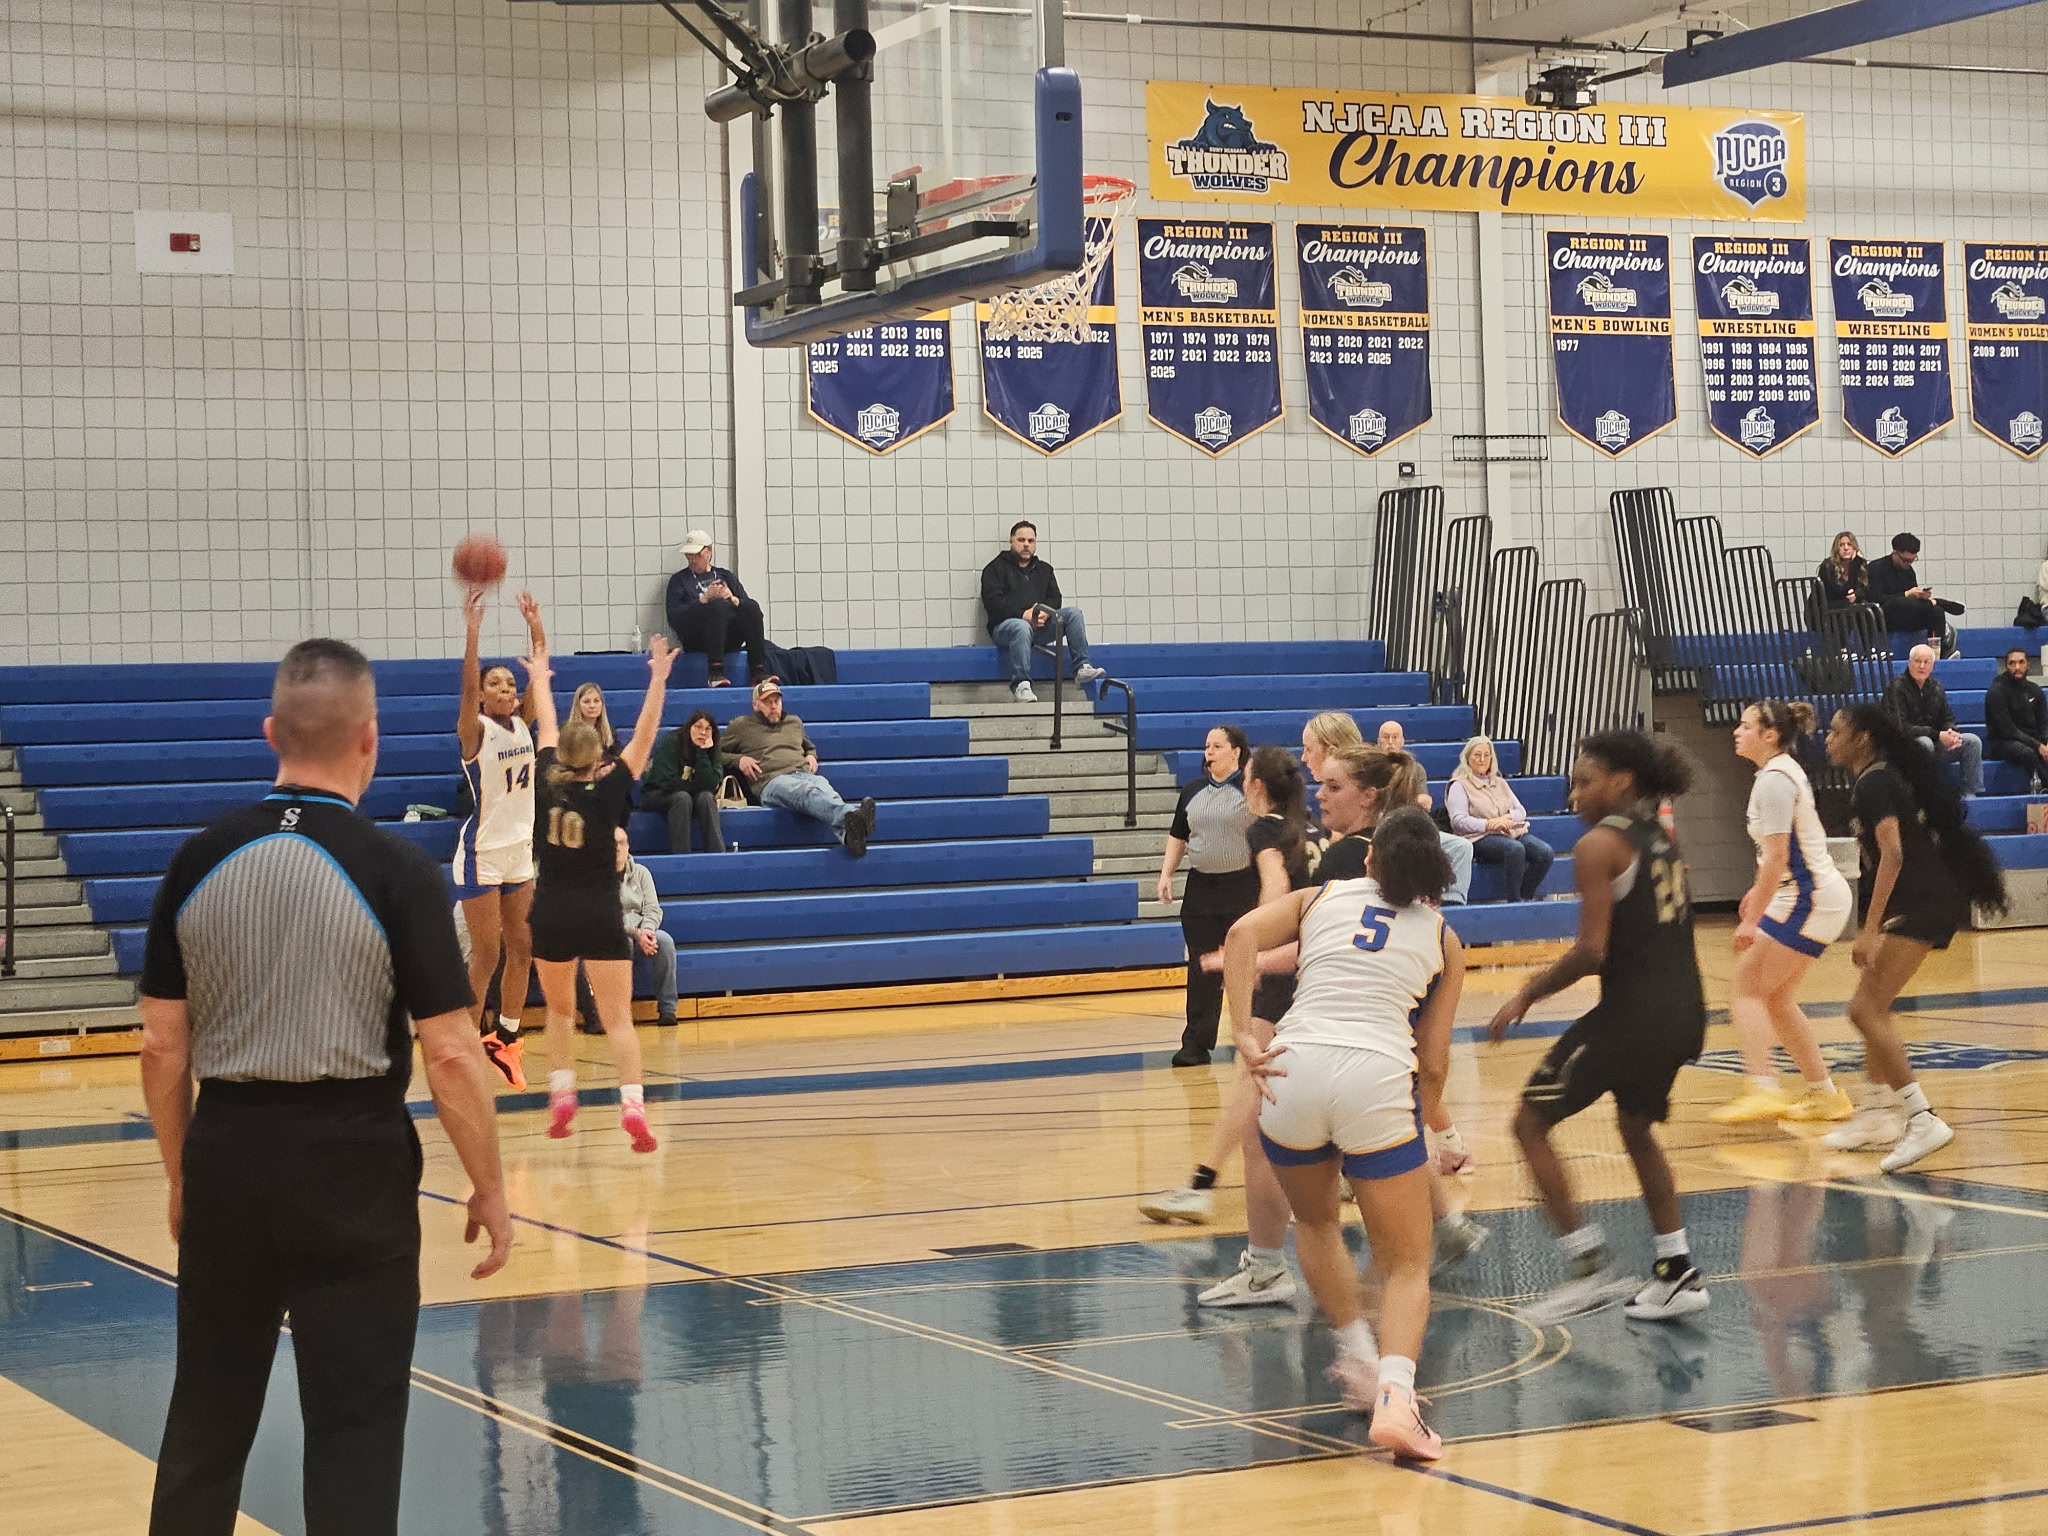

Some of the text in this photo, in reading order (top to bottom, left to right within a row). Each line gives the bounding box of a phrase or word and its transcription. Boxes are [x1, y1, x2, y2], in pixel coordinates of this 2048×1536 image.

[1302, 99, 1667, 147] NJCAA REGION III
[1166, 145, 1289, 181] THUNDER
[1716, 136, 1786, 176] NJCAA
[1328, 131, 1646, 206] Champions
[1193, 174, 1267, 190] WOLVES
[1729, 177, 1781, 192] REGION 3
[1163, 225, 1249, 240] REGION III
[1320, 230, 1403, 245] REGION III
[1143, 235, 1268, 265] Champions
[1570, 237, 1647, 252] REGION III
[1714, 241, 1789, 255] REGION III
[1851, 245, 1923, 258] REGION III
[1302, 240, 1422, 269] Champions
[1552, 247, 1665, 277] Champions
[1985, 248, 2035, 261] REGION
[1697, 251, 1806, 279] Champions
[1834, 254, 1940, 281] Champions
[1180, 280, 1236, 295] THUNDER
[1337, 285, 1390, 299] THUNDER
[1585, 291, 1634, 304] THUNDER
[1729, 294, 1777, 307] THUNDER
[1143, 310, 1275, 325] MEN'S BASKETBALL
[1303, 313, 1429, 328] WOMEN'S BASKETBALL
[1552, 318, 1670, 333] MEN'S BOWLING
[1713, 322, 1797, 335] WRESTLING
[1848, 323, 1931, 336] WRESTLING
[1969, 327, 2014, 337] WOMEN'S
[881, 327, 908, 340] 2013
[915, 327, 943, 340] 2016
[1150, 331, 1270, 346] 1971 1974 1978 1979
[811, 342, 944, 357] 2017 2021 2022 2023
[1337, 335, 1363, 348] 2020
[1367, 336, 1392, 349] 2021
[1398, 337, 1424, 349] 2022
[1556, 339, 1579, 352] 1977
[1703, 342, 1808, 355] 1991 1993 1994 1995
[1838, 343, 1941, 356] 2012 2013 2014 2017
[985, 345, 1043, 359] 2024 2025
[1149, 348, 1272, 363] 2017 2021 2022 2023
[1338, 352, 1363, 365] 2024
[1367, 352, 1392, 365] 2025
[1973, 345, 2019, 358] 2009 2011
[812, 360, 839, 373] 2025
[1758, 358, 1782, 370] 1999
[1785, 359, 1809, 370] 2000
[1866, 359, 1888, 371] 2019
[1892, 360, 1915, 371] 2020
[1919, 360, 1942, 372] 2021
[1150, 366, 1176, 378] 2025
[1730, 374, 1754, 386] 2003
[1758, 374, 1783, 386] 2004
[1786, 374, 1810, 386] 2005
[1865, 375, 1889, 387] 2024
[1893, 375, 1915, 387] 2025
[1709, 389, 1811, 402] 006 2007 2009 2010
[862, 414, 895, 432] NJCAA
[1033, 416, 1065, 432] NJCAA
[1199, 417, 1227, 433] NJCAA
[1354, 419, 1382, 435] NJCAA
[1599, 421, 1626, 436] NJCAA
[1744, 422, 1770, 437] NJCAA
[1879, 422, 1904, 437] NJCAA
[2013, 422, 2040, 437] NJCAA
[505, 763, 530, 794] 14
[1352, 904, 1397, 953] 5
